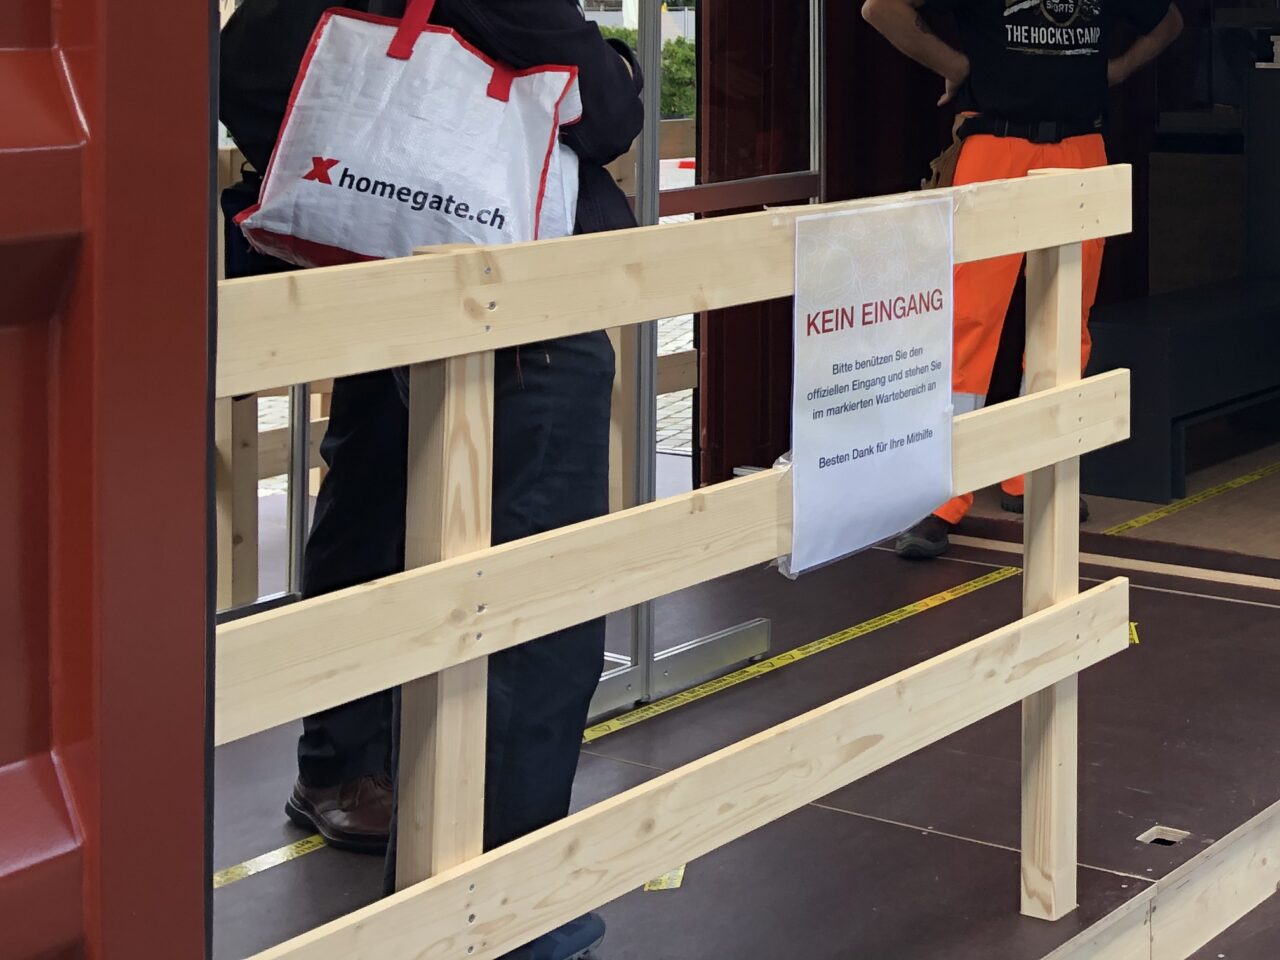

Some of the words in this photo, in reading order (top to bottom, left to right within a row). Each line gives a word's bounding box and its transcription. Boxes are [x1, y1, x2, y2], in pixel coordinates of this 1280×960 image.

[1005, 24, 1030, 44] THE
[1030, 26, 1075, 45] HOCKEY
[1076, 26, 1101, 45] CAMP
[338, 167, 506, 231] homegate.ch
[806, 305, 855, 337] KEIN
[861, 288, 944, 327] EINGANG
[807, 384, 850, 401] offiziellen
[852, 375, 886, 391] Eingang
[887, 370, 903, 382] und
[904, 363, 929, 379] stehen
[930, 359, 942, 371] Sie
[832, 363, 853, 375] Bitte
[855, 354, 893, 371] benützen
[895, 349, 908, 361] Sie
[909, 346, 923, 358] den
[812, 408, 824, 420] im
[826, 397, 873, 417] markierten
[875, 383, 926, 405] Wartebereich
[927, 381, 937, 392] an
[818, 452, 850, 469] Besten
[852, 445, 875, 460] Dank
[876, 441, 888, 454] für
[889, 437, 905, 450] Ihre
[906, 428, 933, 445] Mithilfe
